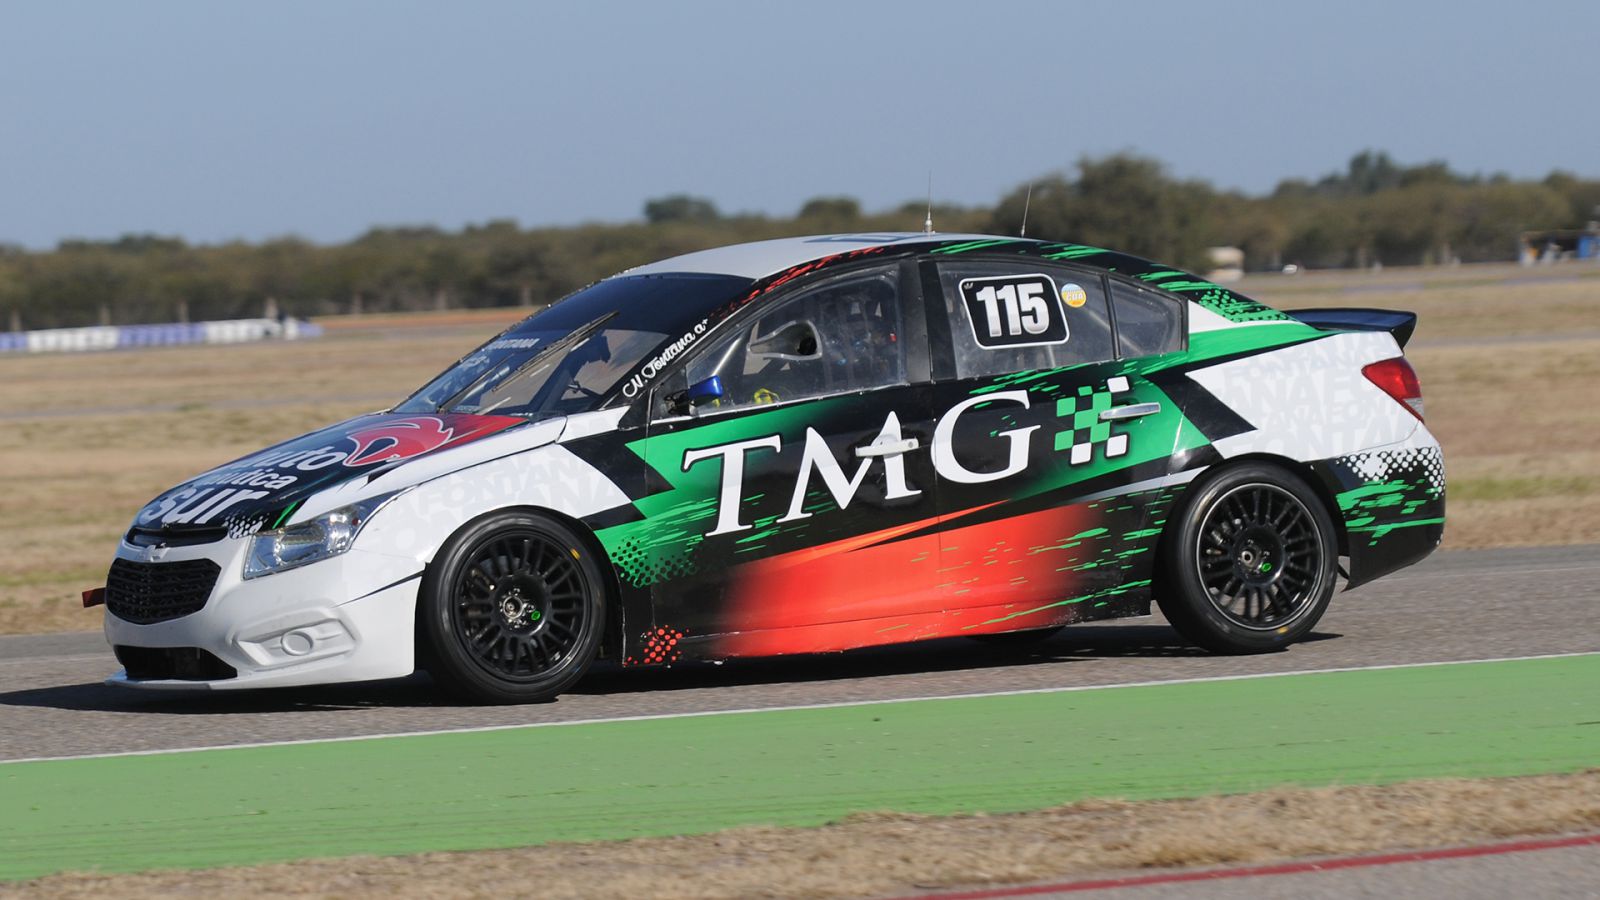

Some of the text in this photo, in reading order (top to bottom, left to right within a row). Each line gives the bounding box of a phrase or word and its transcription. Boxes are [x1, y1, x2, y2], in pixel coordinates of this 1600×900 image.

[976, 282, 1051, 338] 115
[681, 389, 1041, 537] TMG
[143, 487, 270, 526] sur
